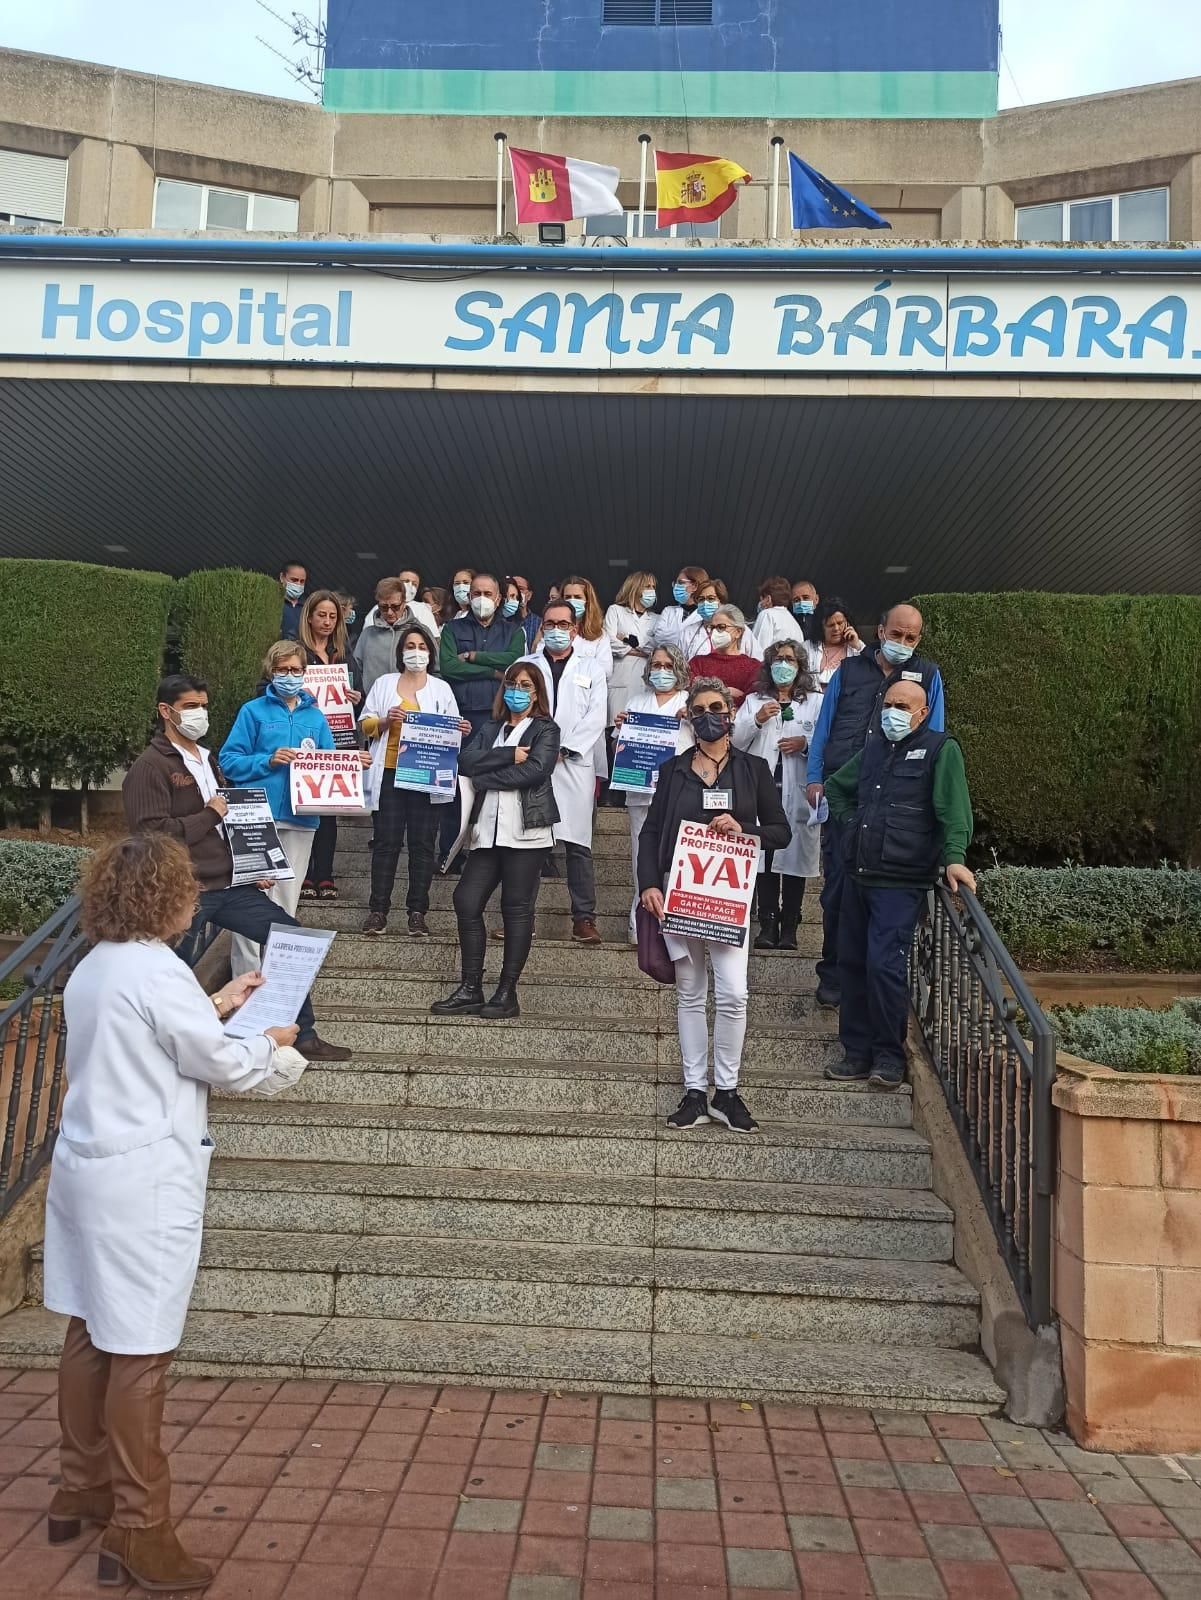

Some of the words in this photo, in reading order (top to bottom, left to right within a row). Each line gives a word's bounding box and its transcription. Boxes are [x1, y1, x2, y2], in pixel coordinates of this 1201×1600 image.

[41, 283, 353, 357] Hospital
[444, 290, 735, 355] SANTA
[293, 762, 361, 772] PROFESIONAL
[295, 752, 360, 762] CARRERA
[295, 773, 359, 805] ¡YA!
[684, 825, 757, 847] CARRERA
[680, 836, 756, 859] PROFESIONAL
[675, 852, 752, 890] ¡YA!
[672, 906, 695, 916] CUMPLA
[707, 912, 738, 923] PROMESAS
